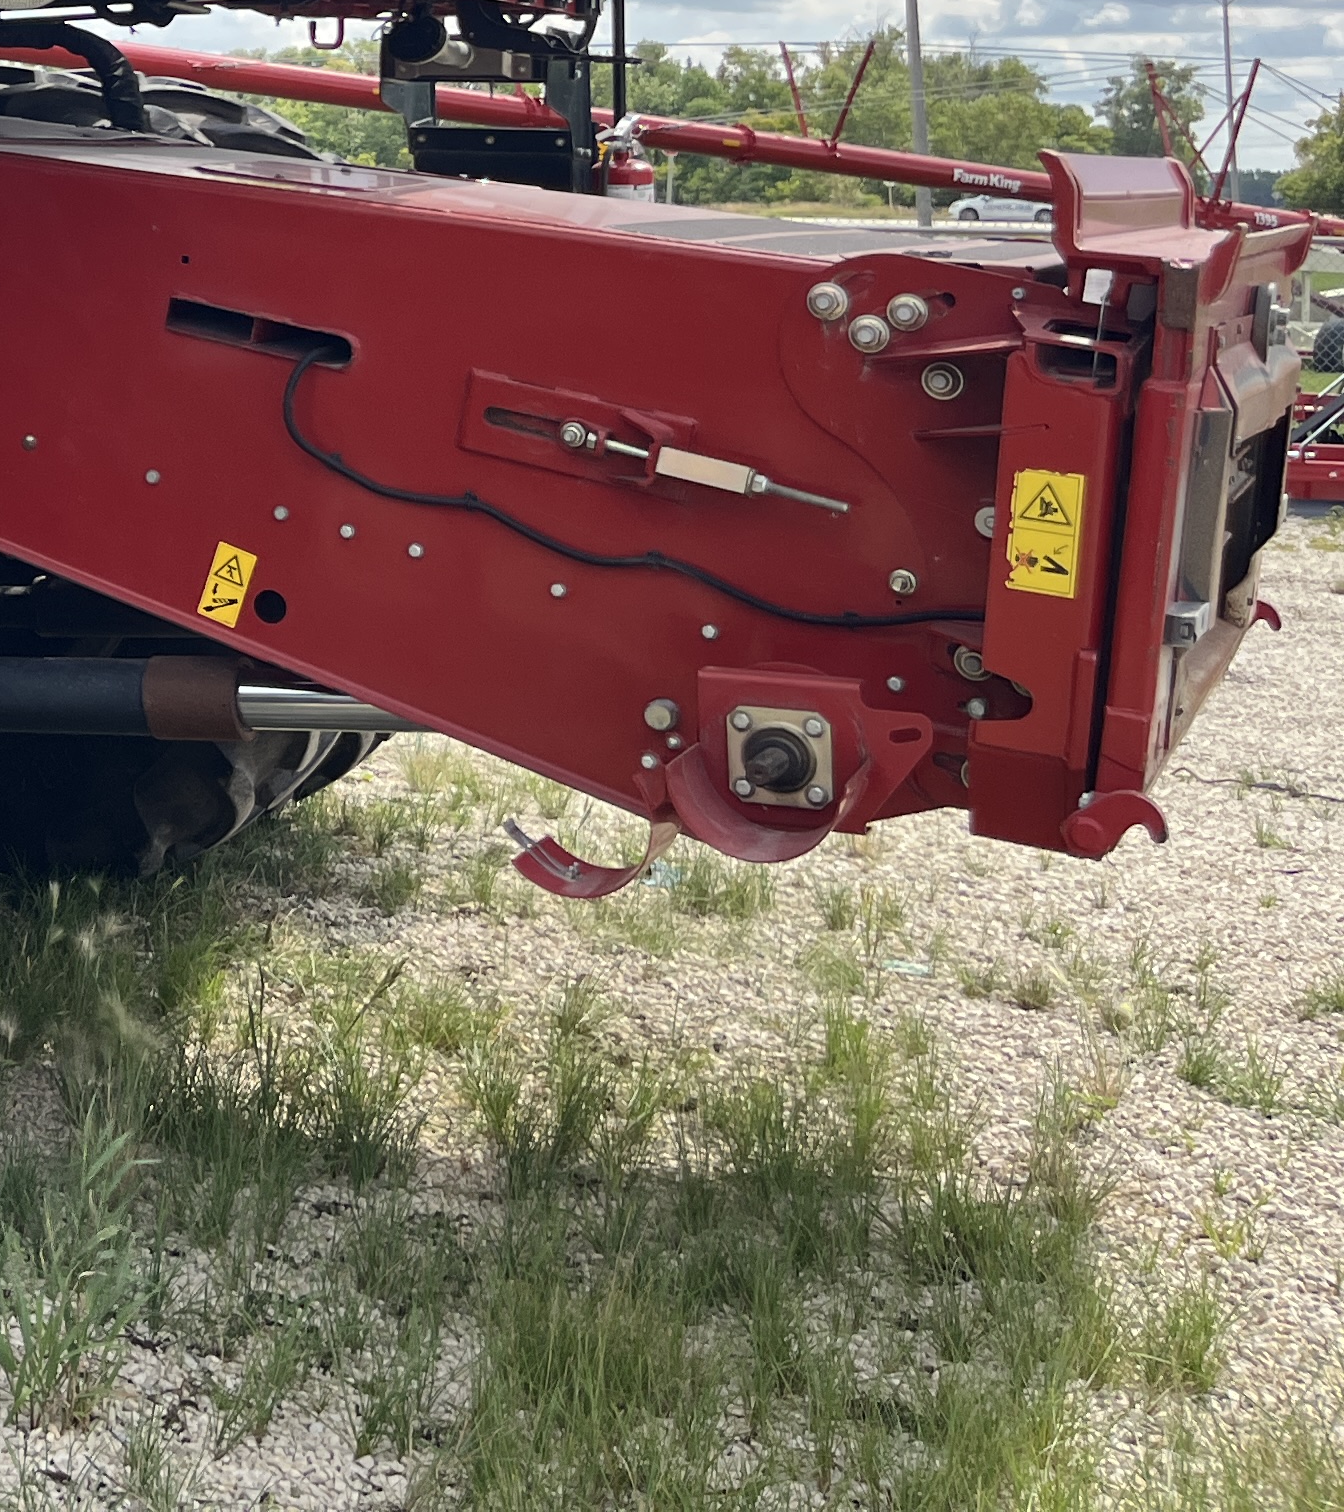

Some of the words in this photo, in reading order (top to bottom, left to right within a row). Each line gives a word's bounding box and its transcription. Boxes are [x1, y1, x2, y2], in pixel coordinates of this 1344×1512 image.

[953, 168, 989, 187] Farm
[989, 173, 1022, 193] King
[1254, 211, 1278, 228] 1395
